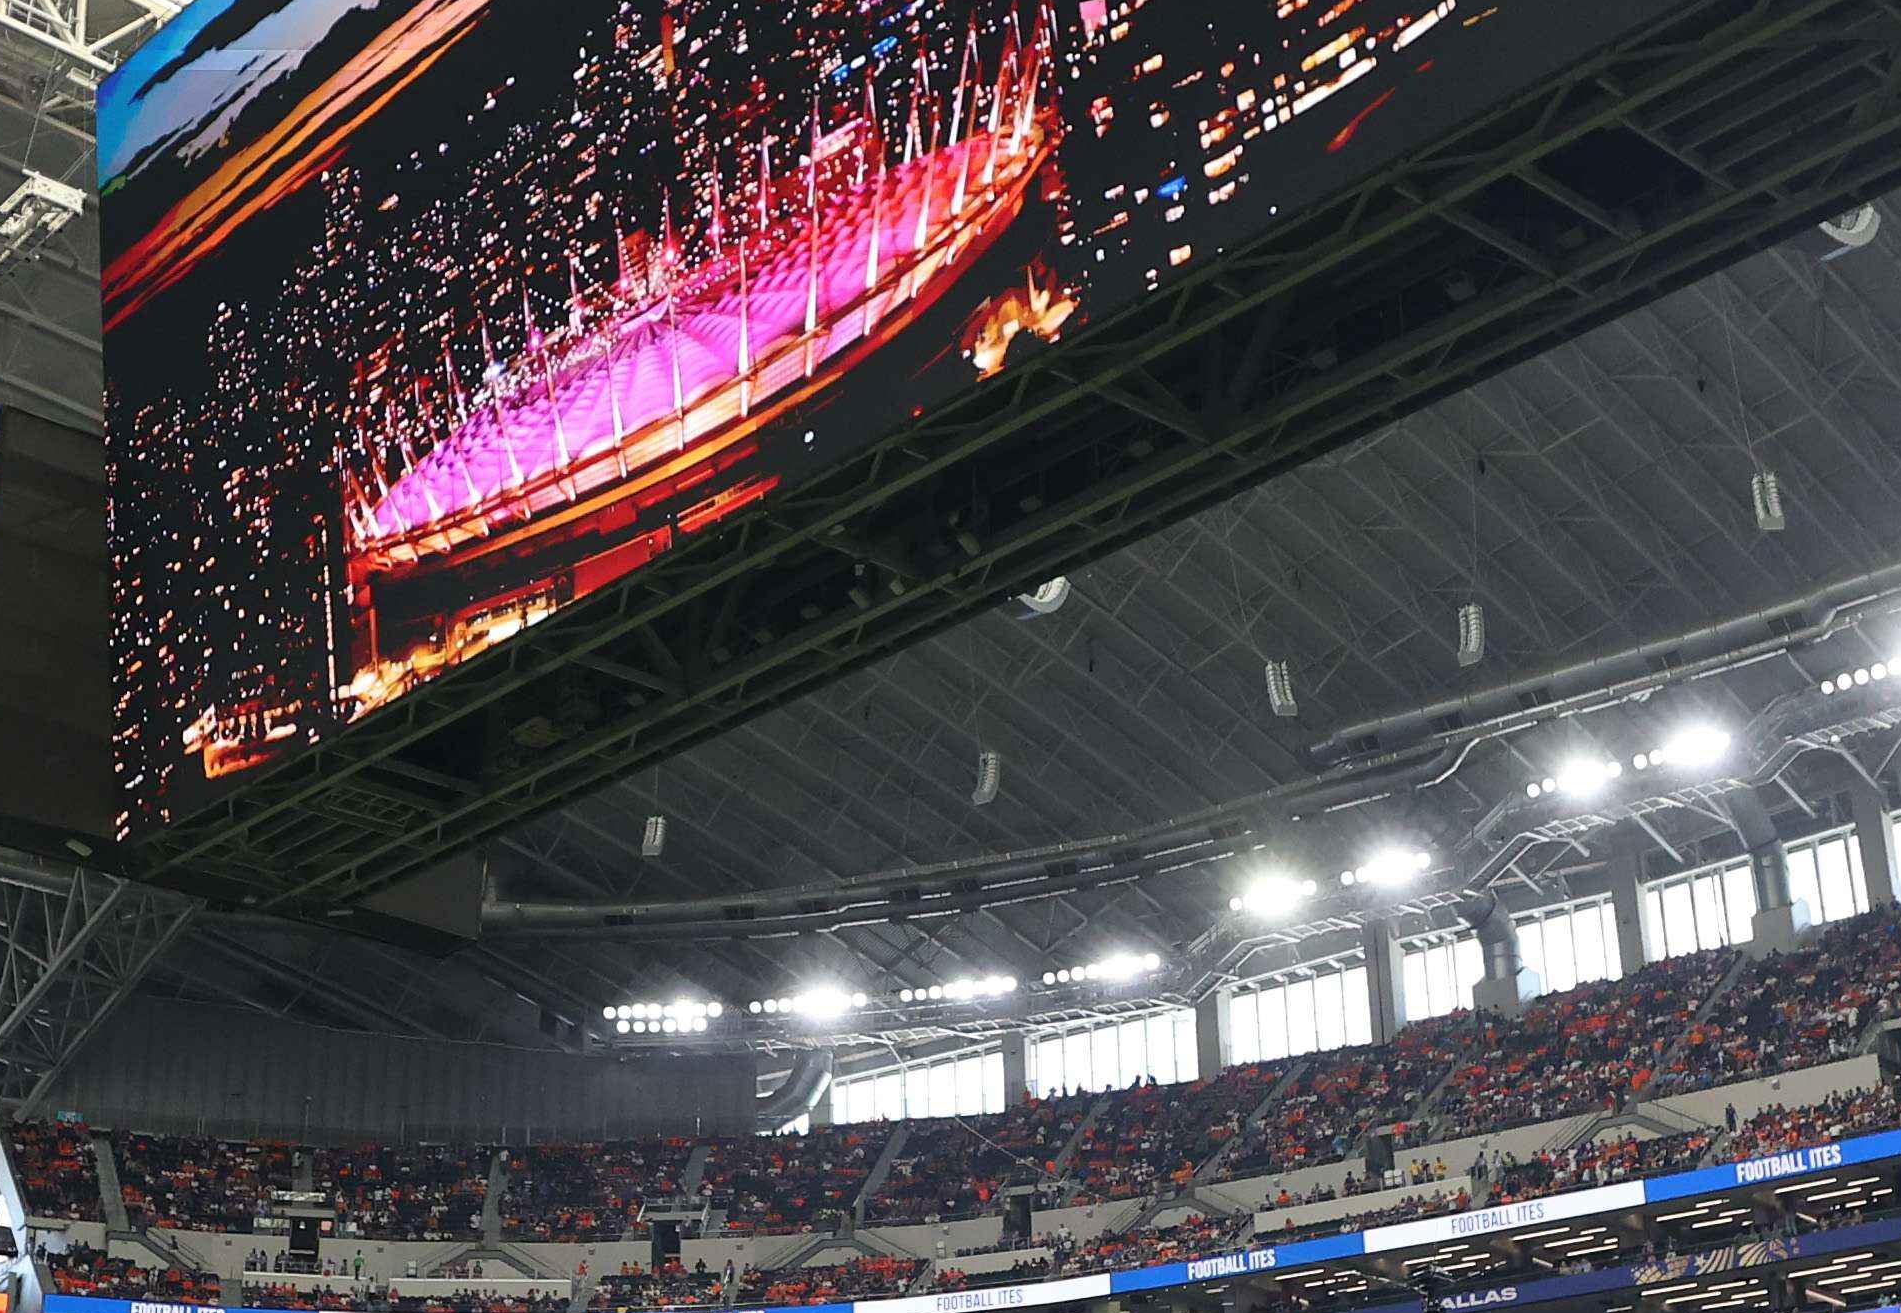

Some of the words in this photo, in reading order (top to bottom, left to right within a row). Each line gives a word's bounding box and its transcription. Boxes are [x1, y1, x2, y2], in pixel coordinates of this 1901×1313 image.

[1736, 1150, 1807, 1183] FOOTBALL
[1451, 1208, 1514, 1234] FOOTBALL
[1188, 1253, 1247, 1280] FOOTBALL
[937, 1292, 995, 1311] FOOTBALL
[1439, 1287, 1518, 1310] ALLAS
